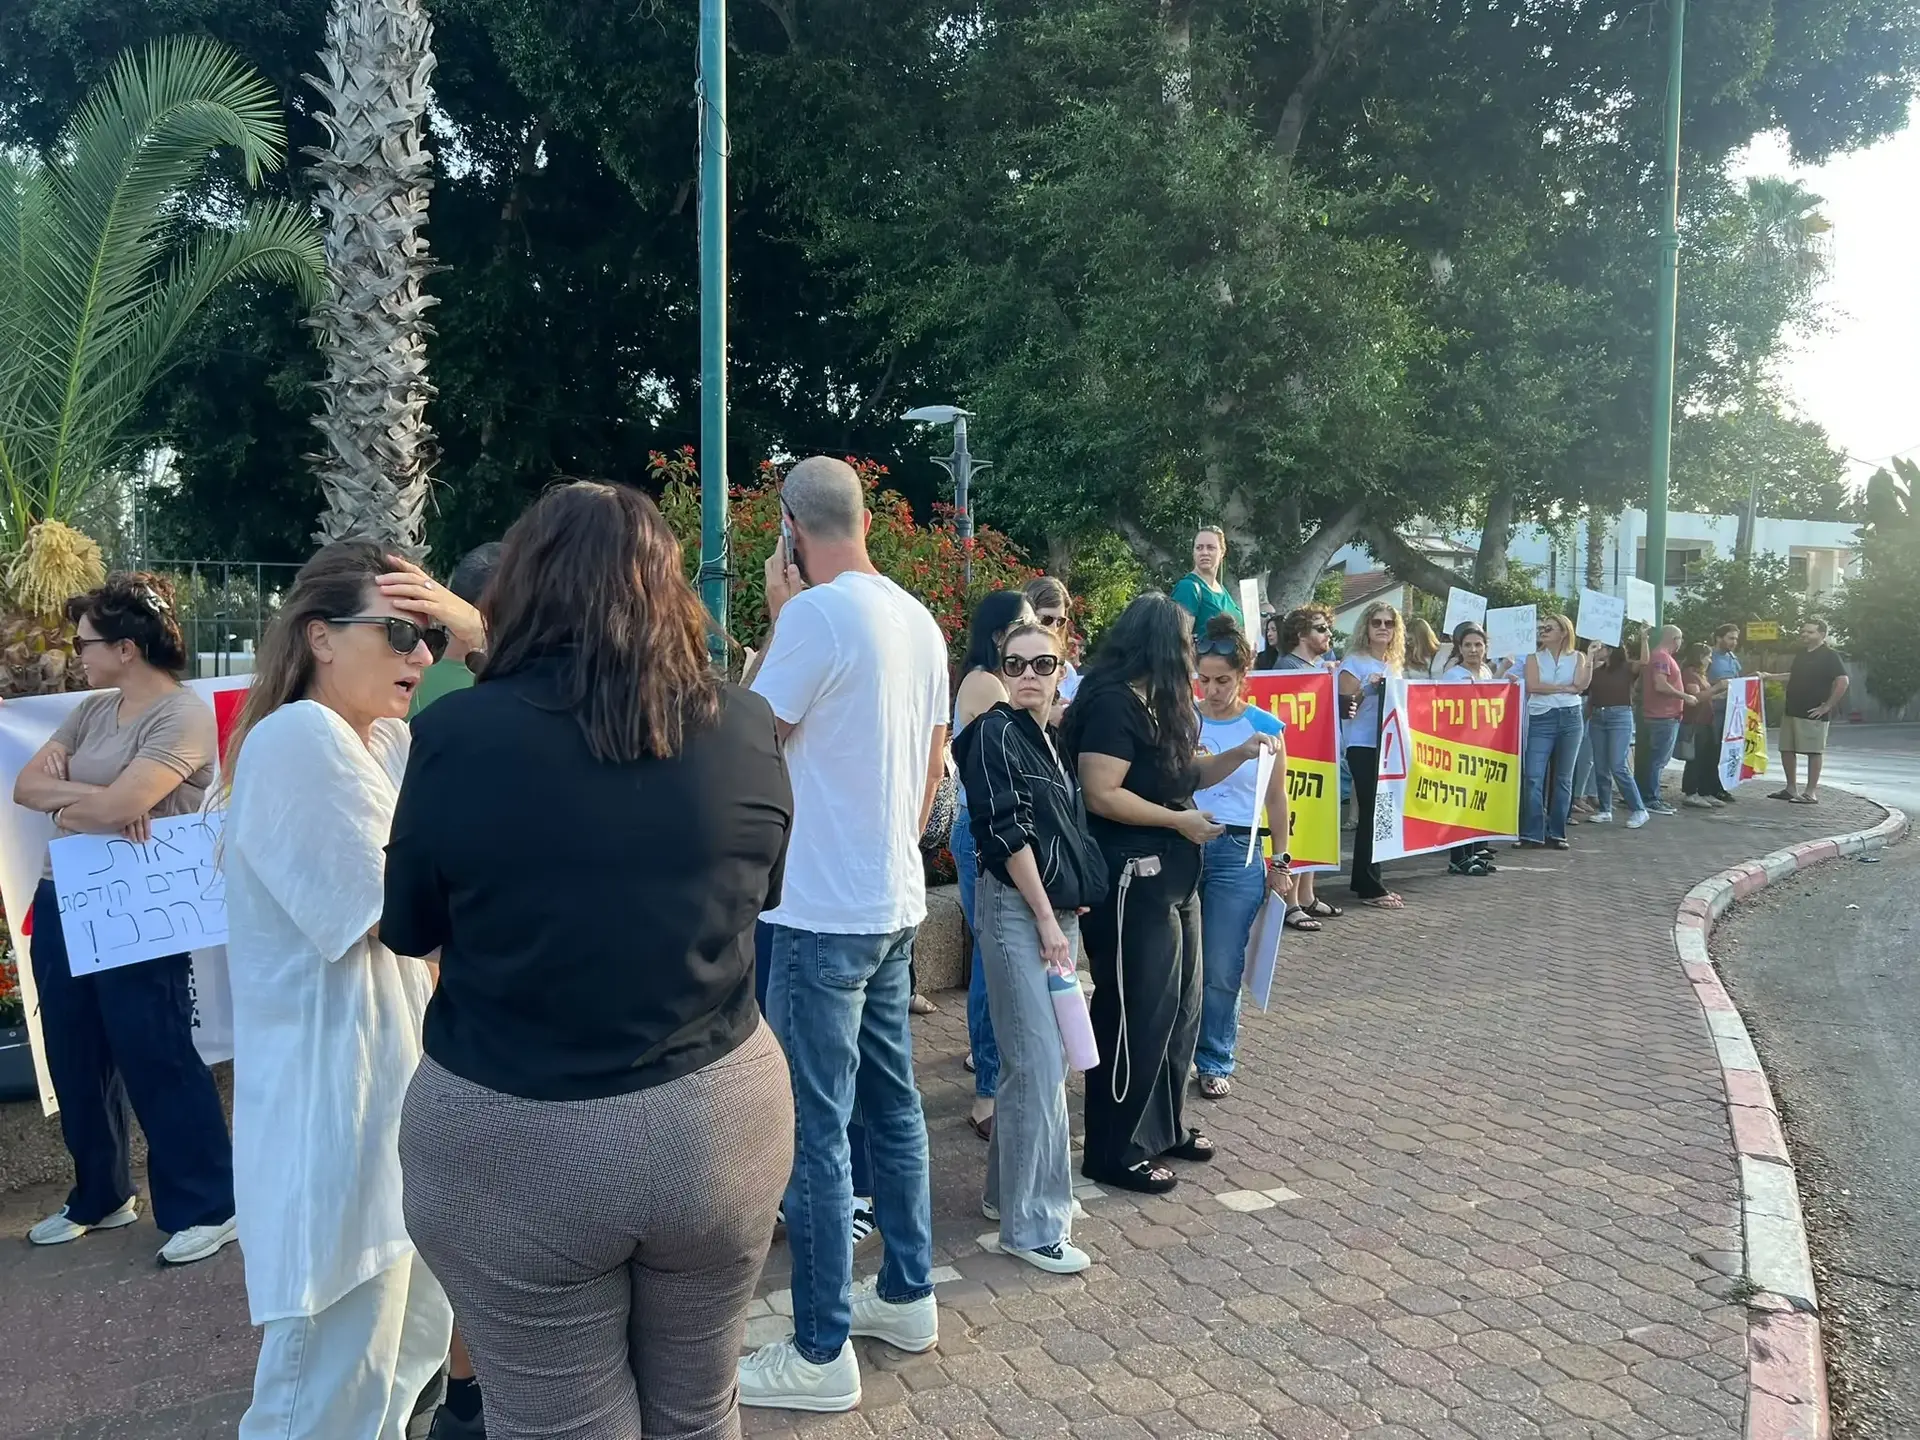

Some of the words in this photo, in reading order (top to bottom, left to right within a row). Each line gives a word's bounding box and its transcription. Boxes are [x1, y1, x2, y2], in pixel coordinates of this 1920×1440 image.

[1269, 692, 1317, 731] קרן
[1470, 697, 1505, 730] קרן
[1286, 769, 1324, 801] הקר
[1470, 789, 1488, 811] את
[88, 821, 222, 876] ריאות
